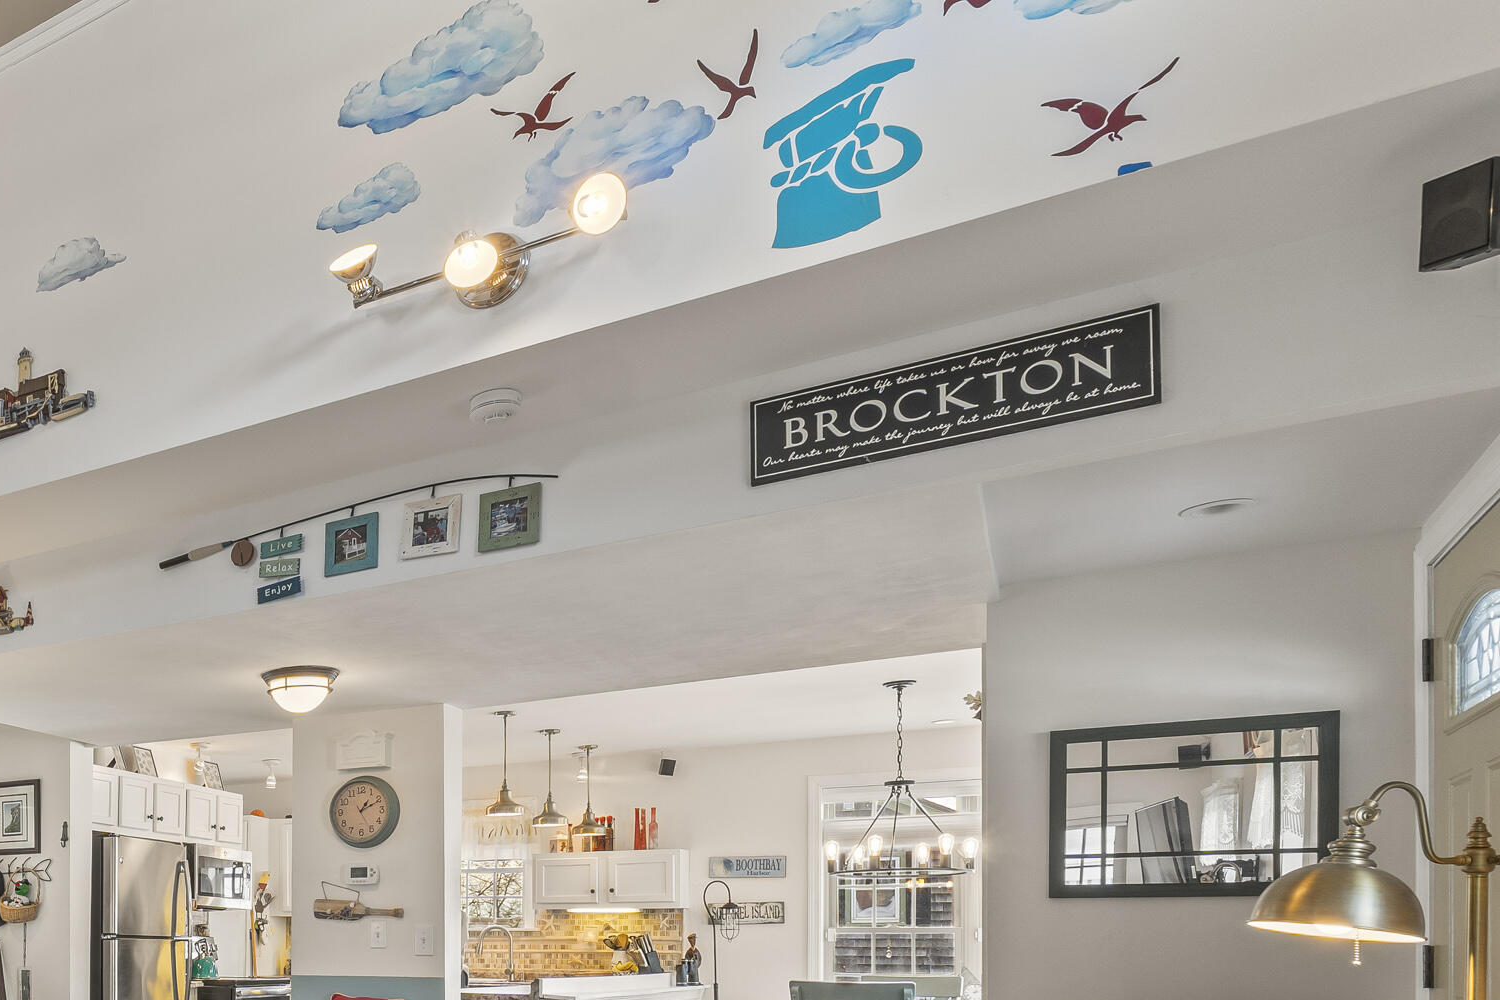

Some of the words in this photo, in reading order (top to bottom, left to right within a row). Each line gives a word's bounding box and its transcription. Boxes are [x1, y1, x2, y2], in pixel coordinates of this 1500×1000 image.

[776, 400, 794, 414] No
[796, 394, 833, 408] matter
[836, 385, 871, 399] where
[873, 378, 893, 394] life
[896, 371, 927, 385] takes
[930, 367, 948, 377] us
[950, 363, 966, 371] or
[968, 356, 996, 368] how
[995, 350, 1020, 367] far
[1022, 341, 1058, 358] away
[1061, 336, 1082, 346] we
[782, 344, 1115, 450] BROCKTON
[762, 456, 786, 468] Our
[787, 449, 823, 462] hearts
[825, 443, 850, 458] may
[852, 435, 883, 448] make
[885, 428, 904, 441] the
[902, 421, 954, 445] journey
[956, 414, 980, 427] but
[982, 405, 1011, 420] will
[1014, 398, 1062, 416] always
[1065, 391, 1082, 403] be
[1084, 388, 1101, 399] at
[270, 541, 293, 552] Live
[265, 562, 294, 573] Relax
[264, 583, 293, 597] Enjoy
[356, 786, 366, 794] 12
[340, 798, 349, 806] 10
[735, 858, 782, 871] BOOTHBAY
[751, 904, 781, 919] ISLAND
